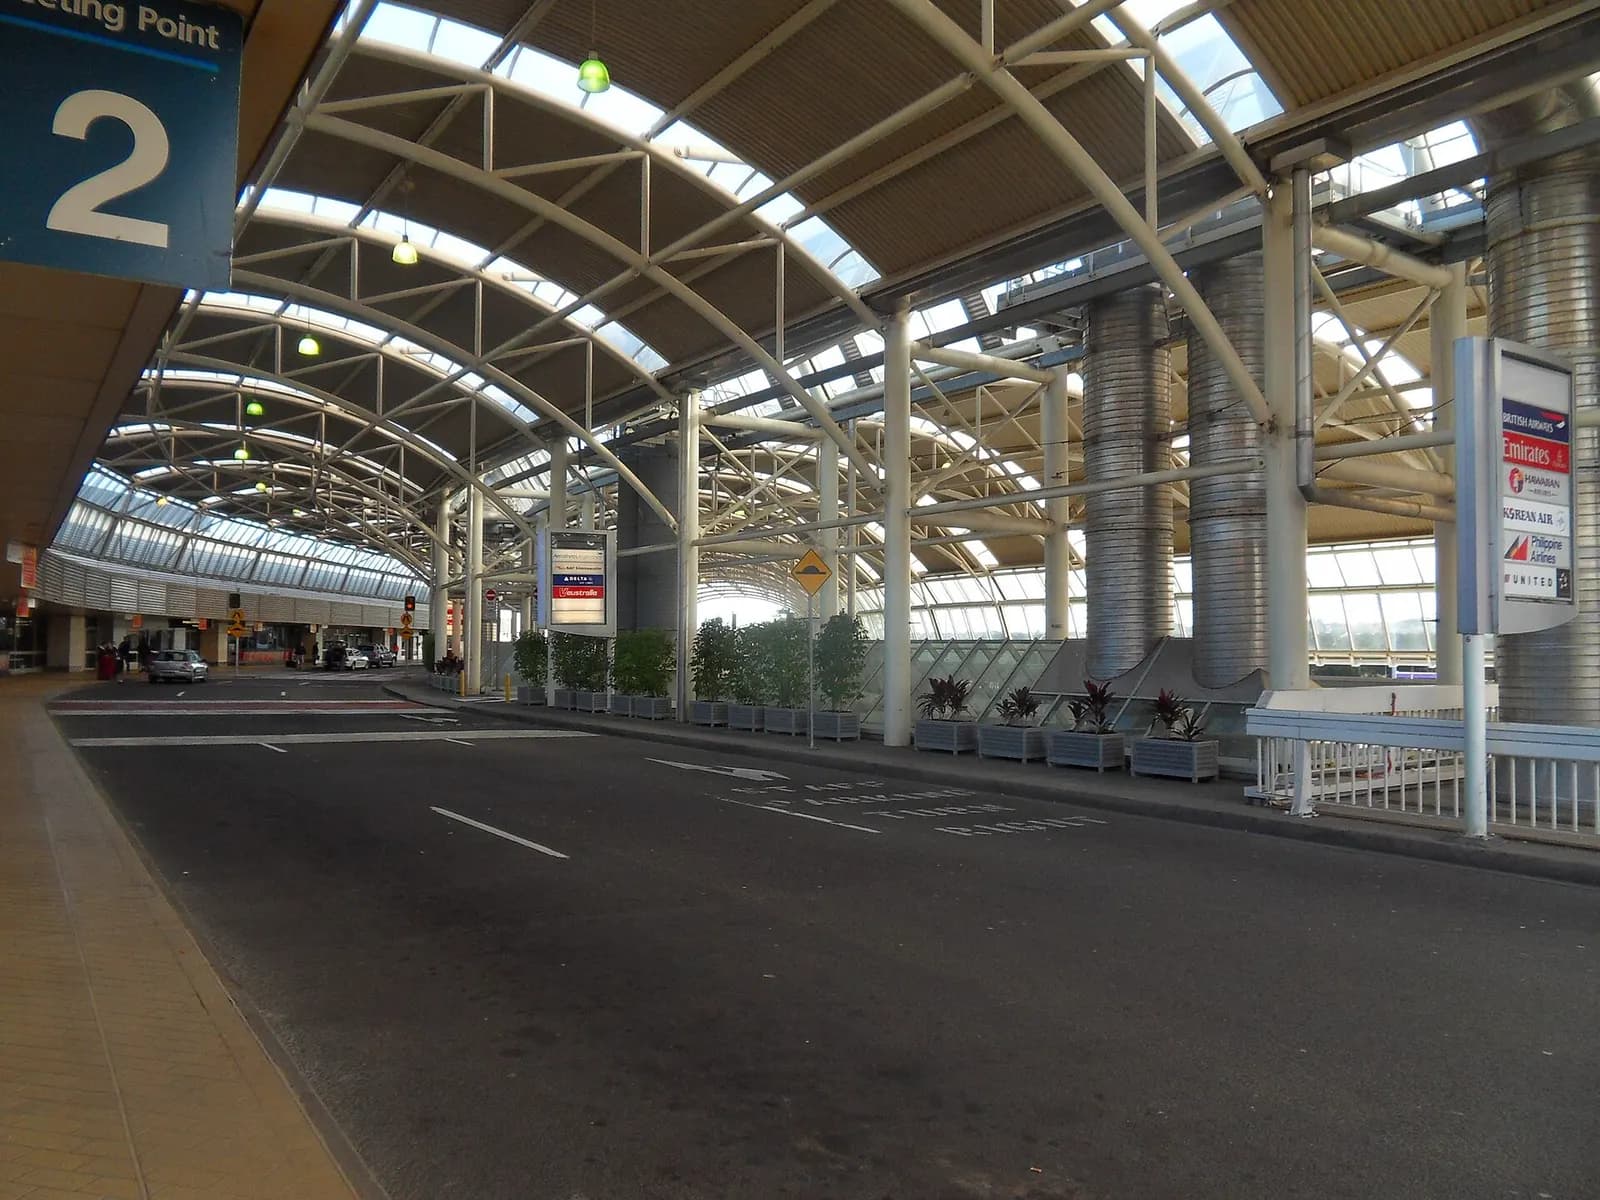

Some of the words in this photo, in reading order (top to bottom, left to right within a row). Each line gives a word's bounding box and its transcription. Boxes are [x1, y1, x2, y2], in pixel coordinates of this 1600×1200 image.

[138, 5, 220, 49] Point
[46, 89, 169, 248] 2
[1503, 411, 1528, 428] BRITISH
[1528, 418, 1554, 433] AIRWAYS
[1503, 437, 1550, 465] Emirates
[1537, 512, 1553, 525] AIR
[1513, 574, 1553, 587] UNITED
[862, 804, 1016, 819] TURN
[934, 815, 1109, 836] RIGHT
